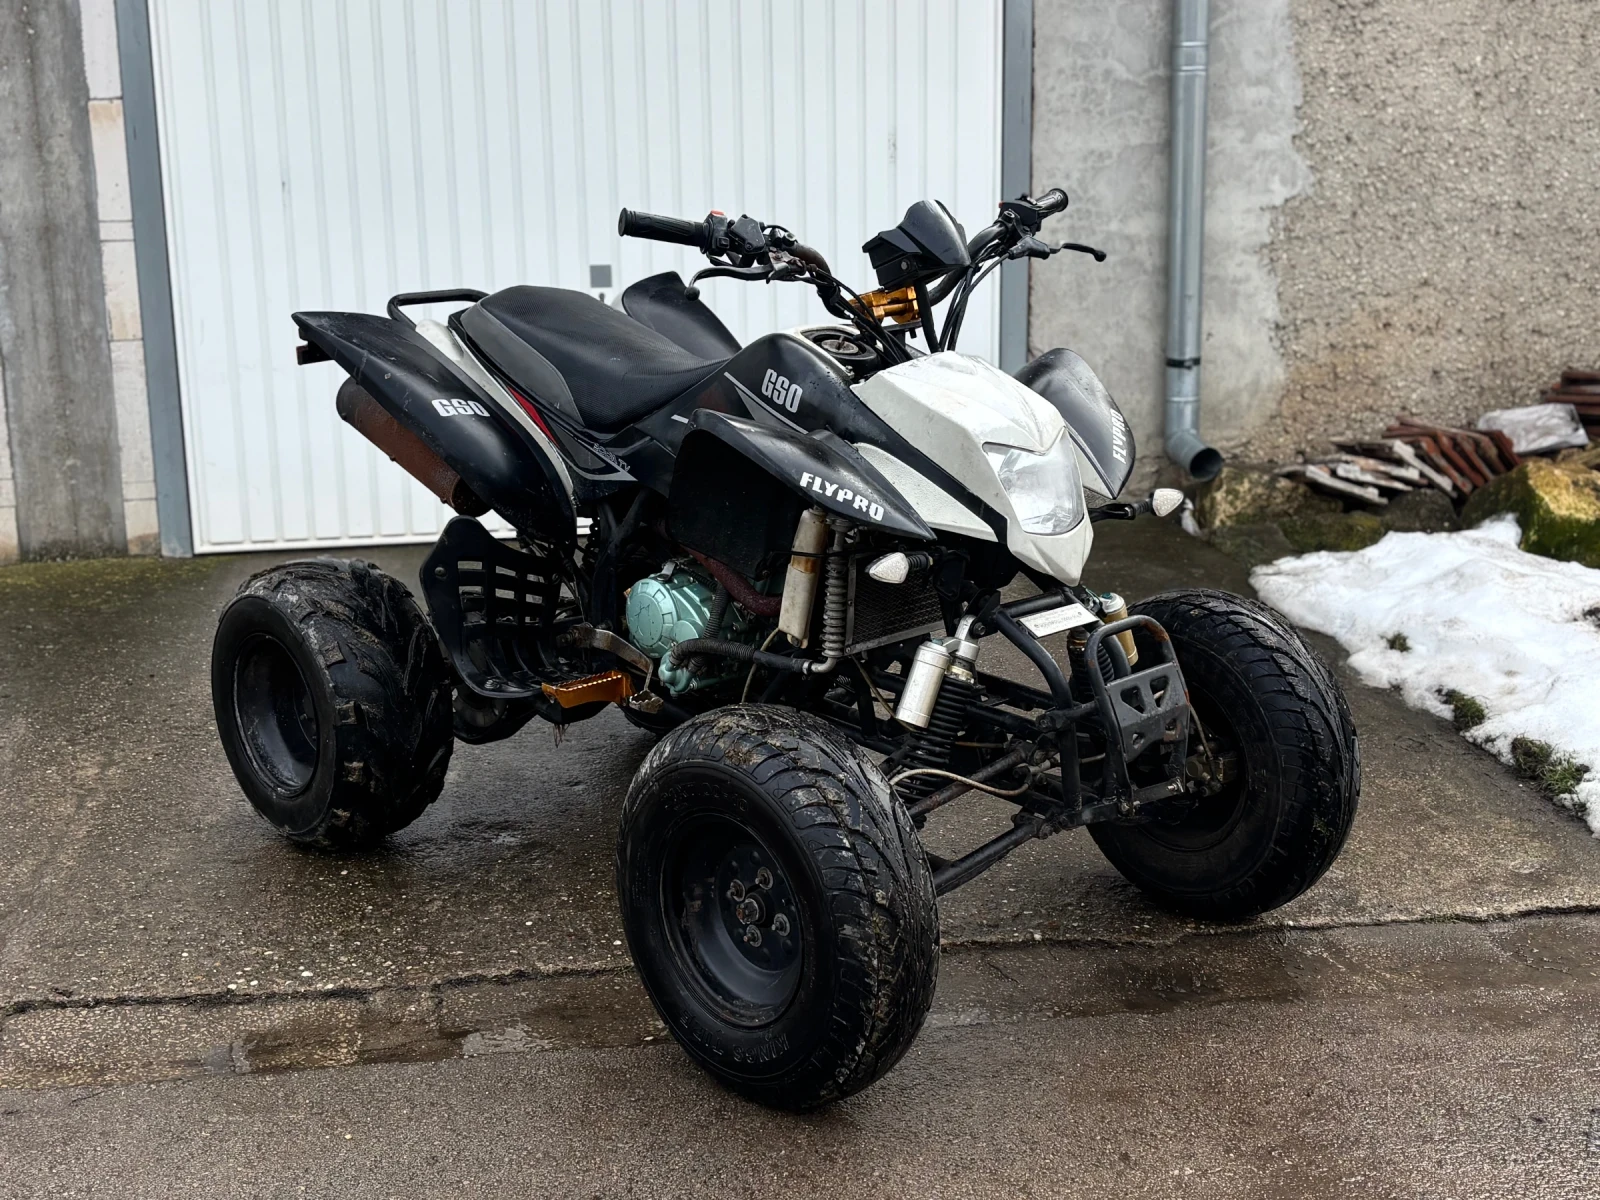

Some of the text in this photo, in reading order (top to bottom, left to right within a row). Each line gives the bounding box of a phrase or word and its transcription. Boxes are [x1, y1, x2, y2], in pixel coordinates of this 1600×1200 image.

[1110, 408, 1127, 465] FLYPRO
[799, 471, 885, 522] FLYPRO
[732, 1032, 790, 1064] KINGS
